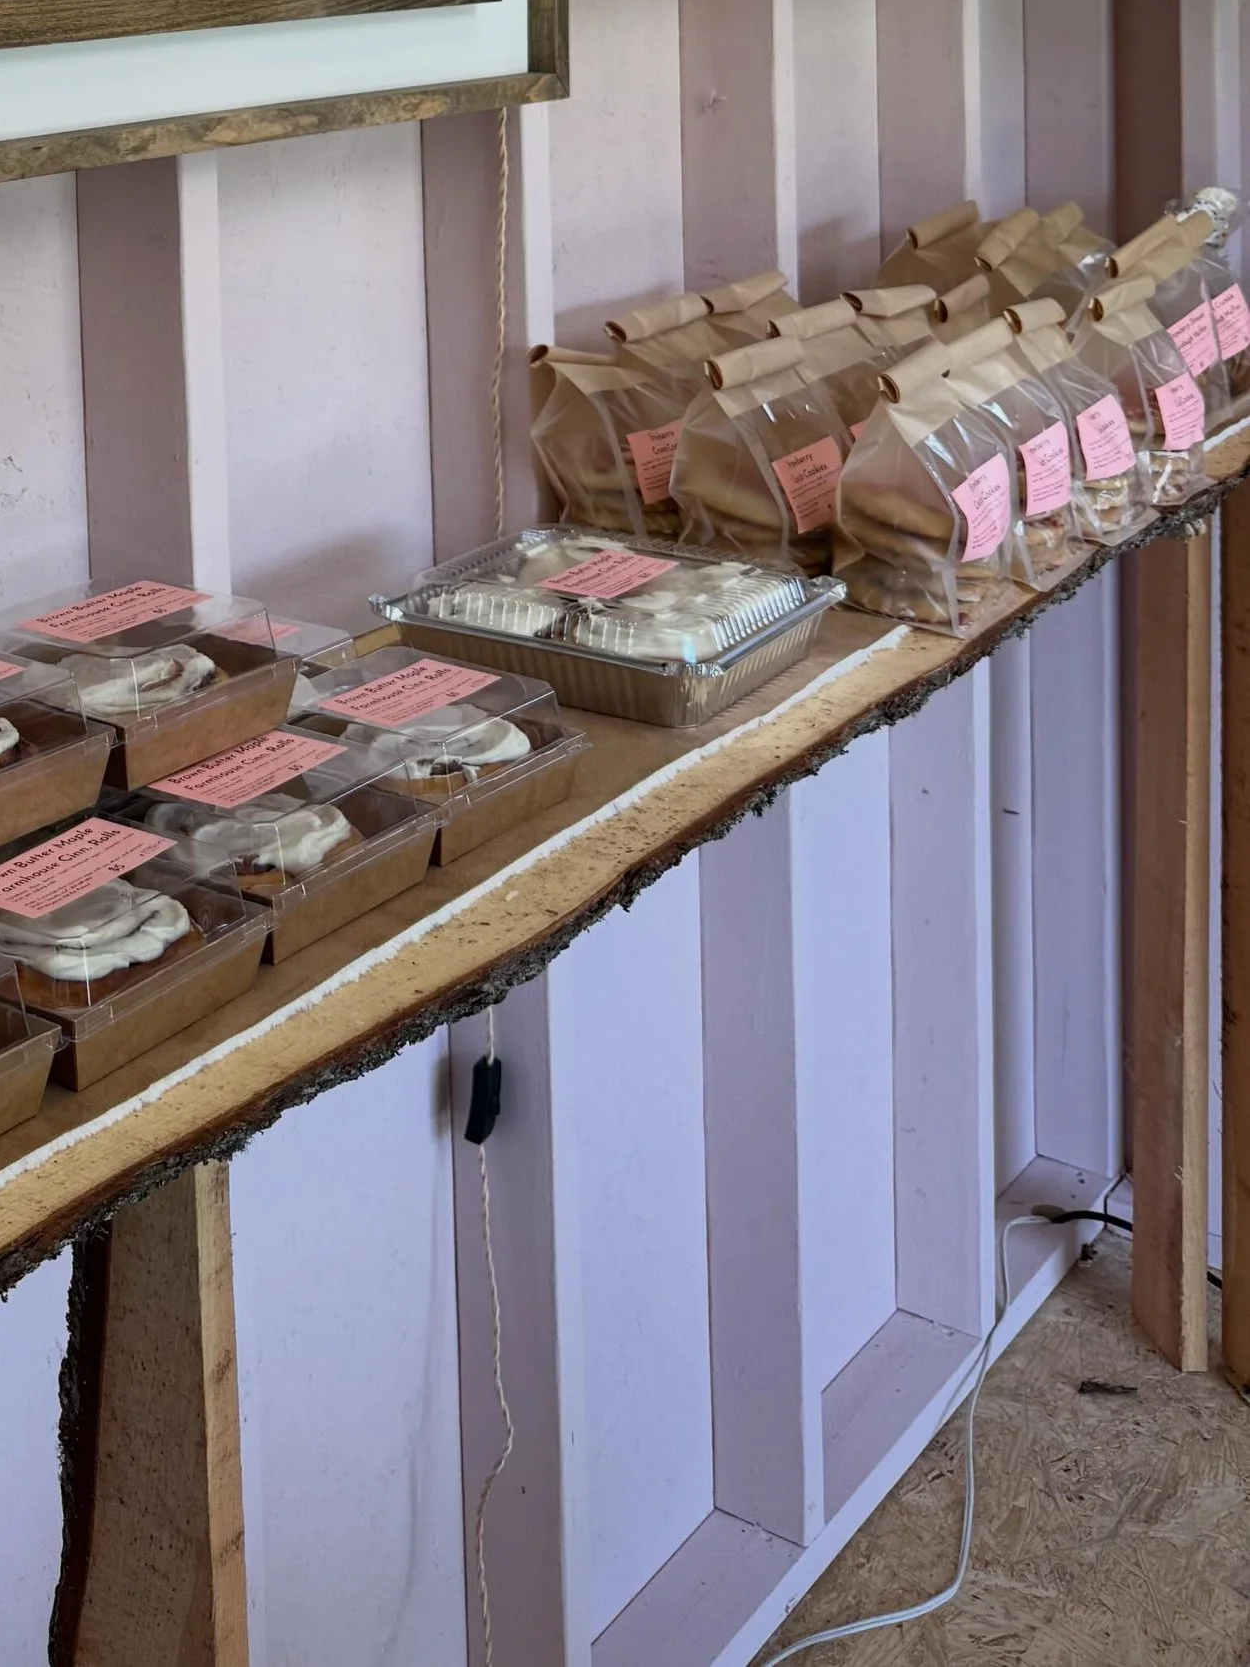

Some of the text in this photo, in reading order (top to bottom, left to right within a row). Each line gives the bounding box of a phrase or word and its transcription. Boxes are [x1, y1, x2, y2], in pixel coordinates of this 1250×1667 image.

[14, 849, 54, 868] Butter
[52, 829, 93, 848] Maple
[88, 831, 120, 846] Rolls
